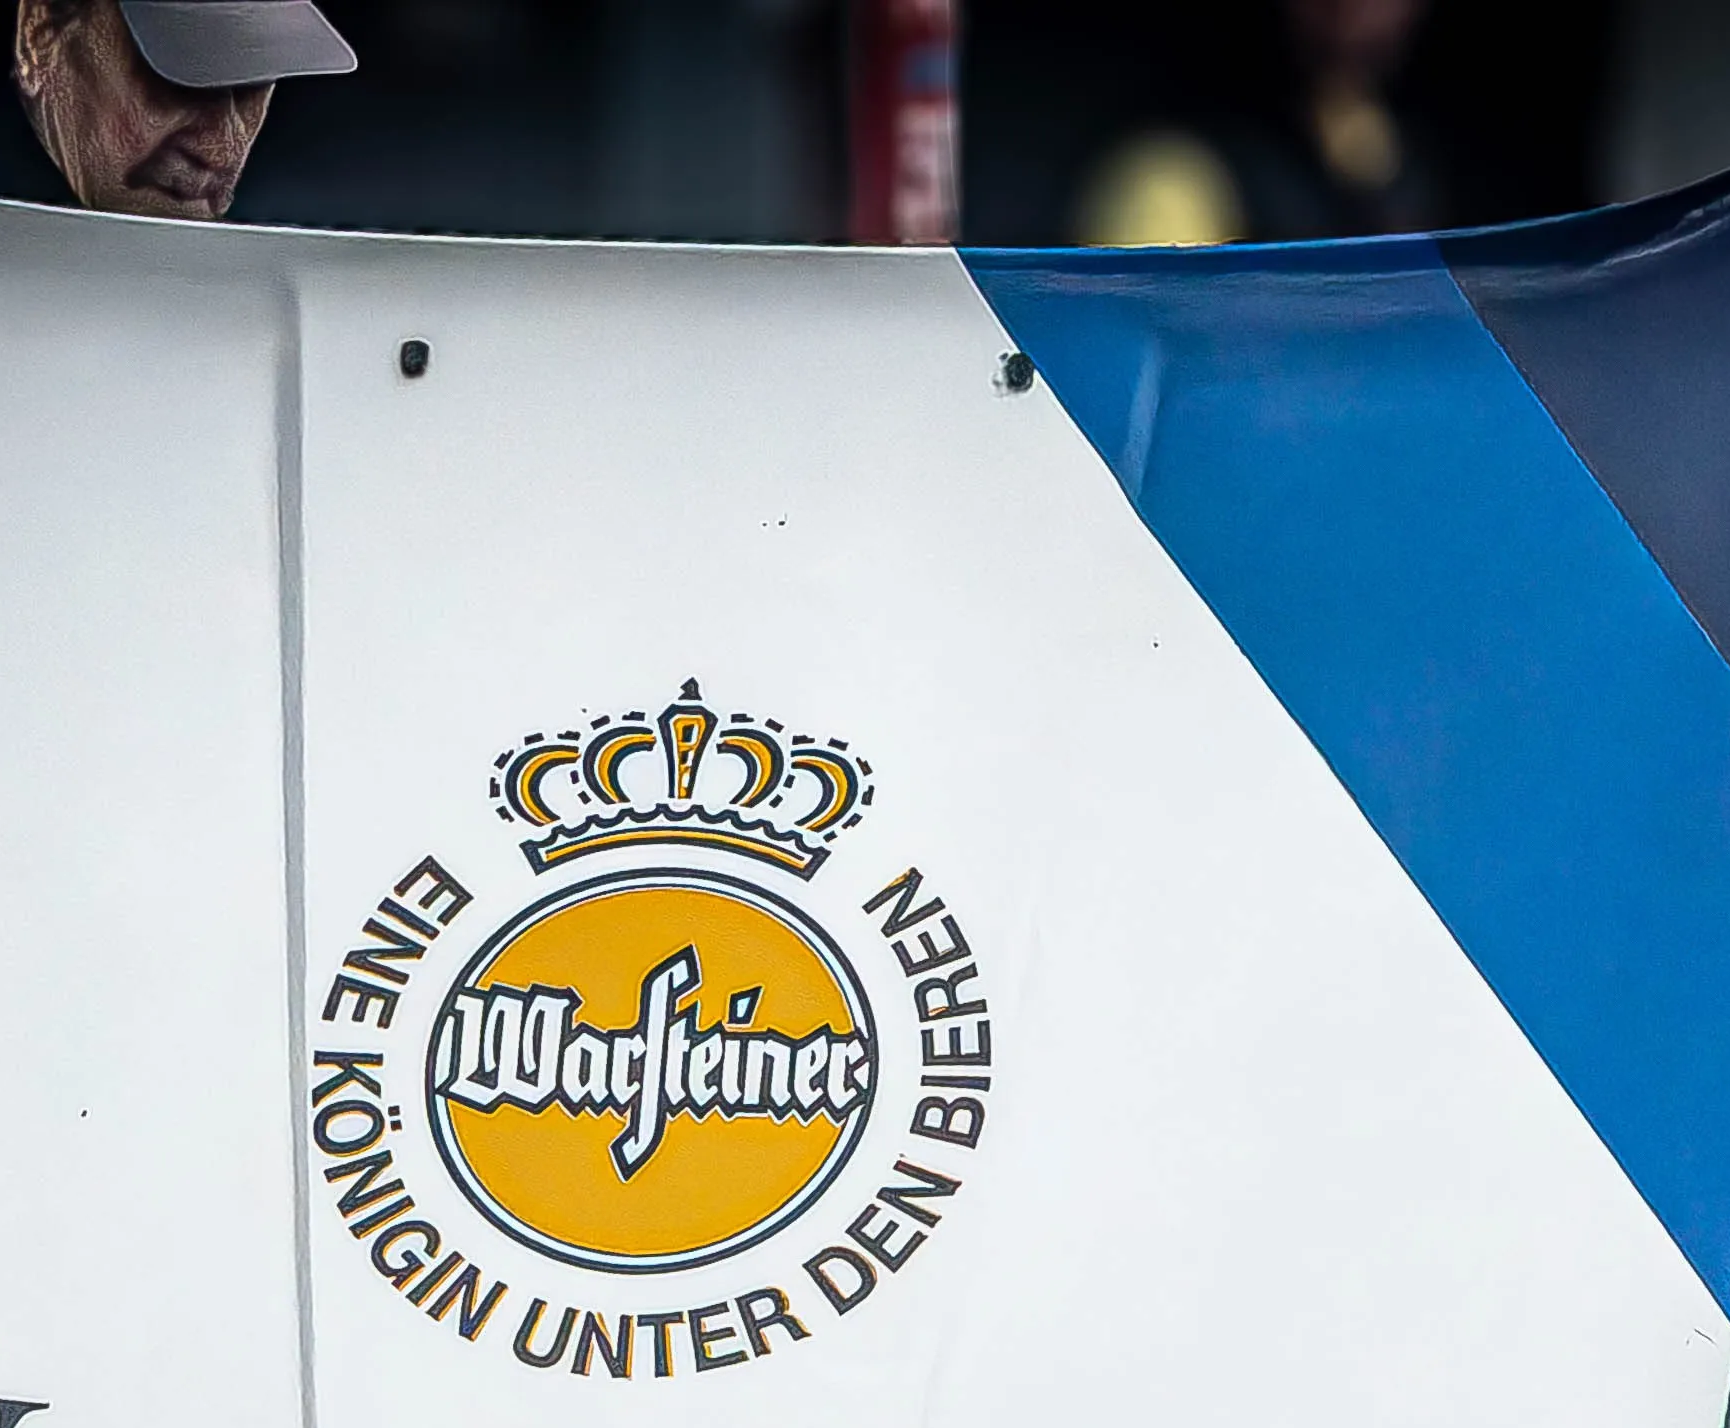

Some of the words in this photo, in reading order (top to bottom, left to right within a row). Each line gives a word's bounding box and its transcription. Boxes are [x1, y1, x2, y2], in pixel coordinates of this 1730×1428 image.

[323, 855, 474, 1030] EINE
[863, 866, 992, 1150] BIEREN
[312, 1050, 508, 1342] KÖNIGIN
[802, 1155, 963, 1316] DEN
[512, 1287, 812, 1379] UNTER
